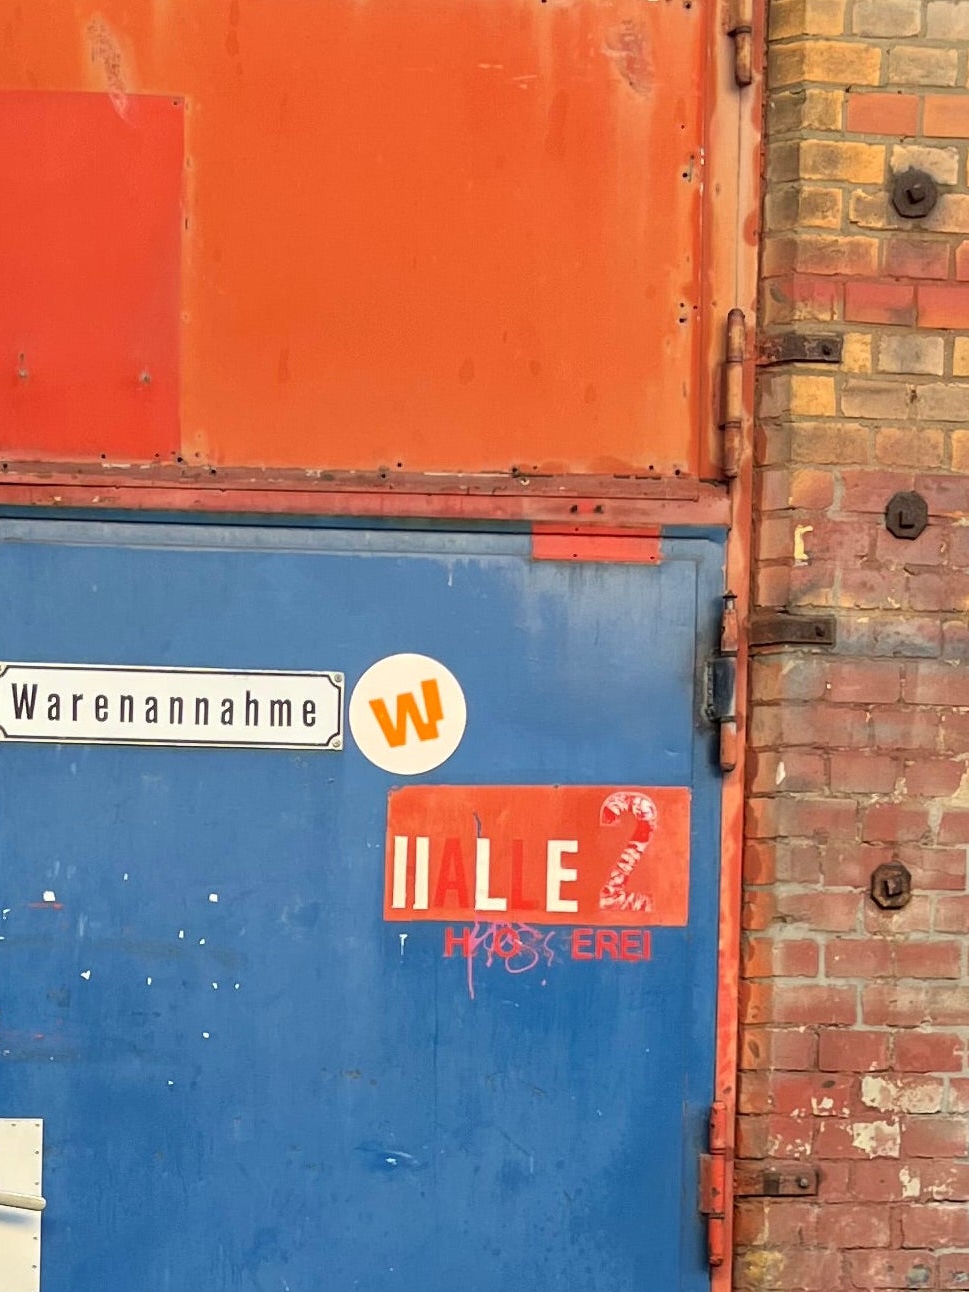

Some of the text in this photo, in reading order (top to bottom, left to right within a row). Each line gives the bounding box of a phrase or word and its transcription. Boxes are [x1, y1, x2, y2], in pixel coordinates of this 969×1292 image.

[11, 682, 318, 727] Warenannahme
[368, 679, 444, 748] W
[600, 791, 658, 913] 2
